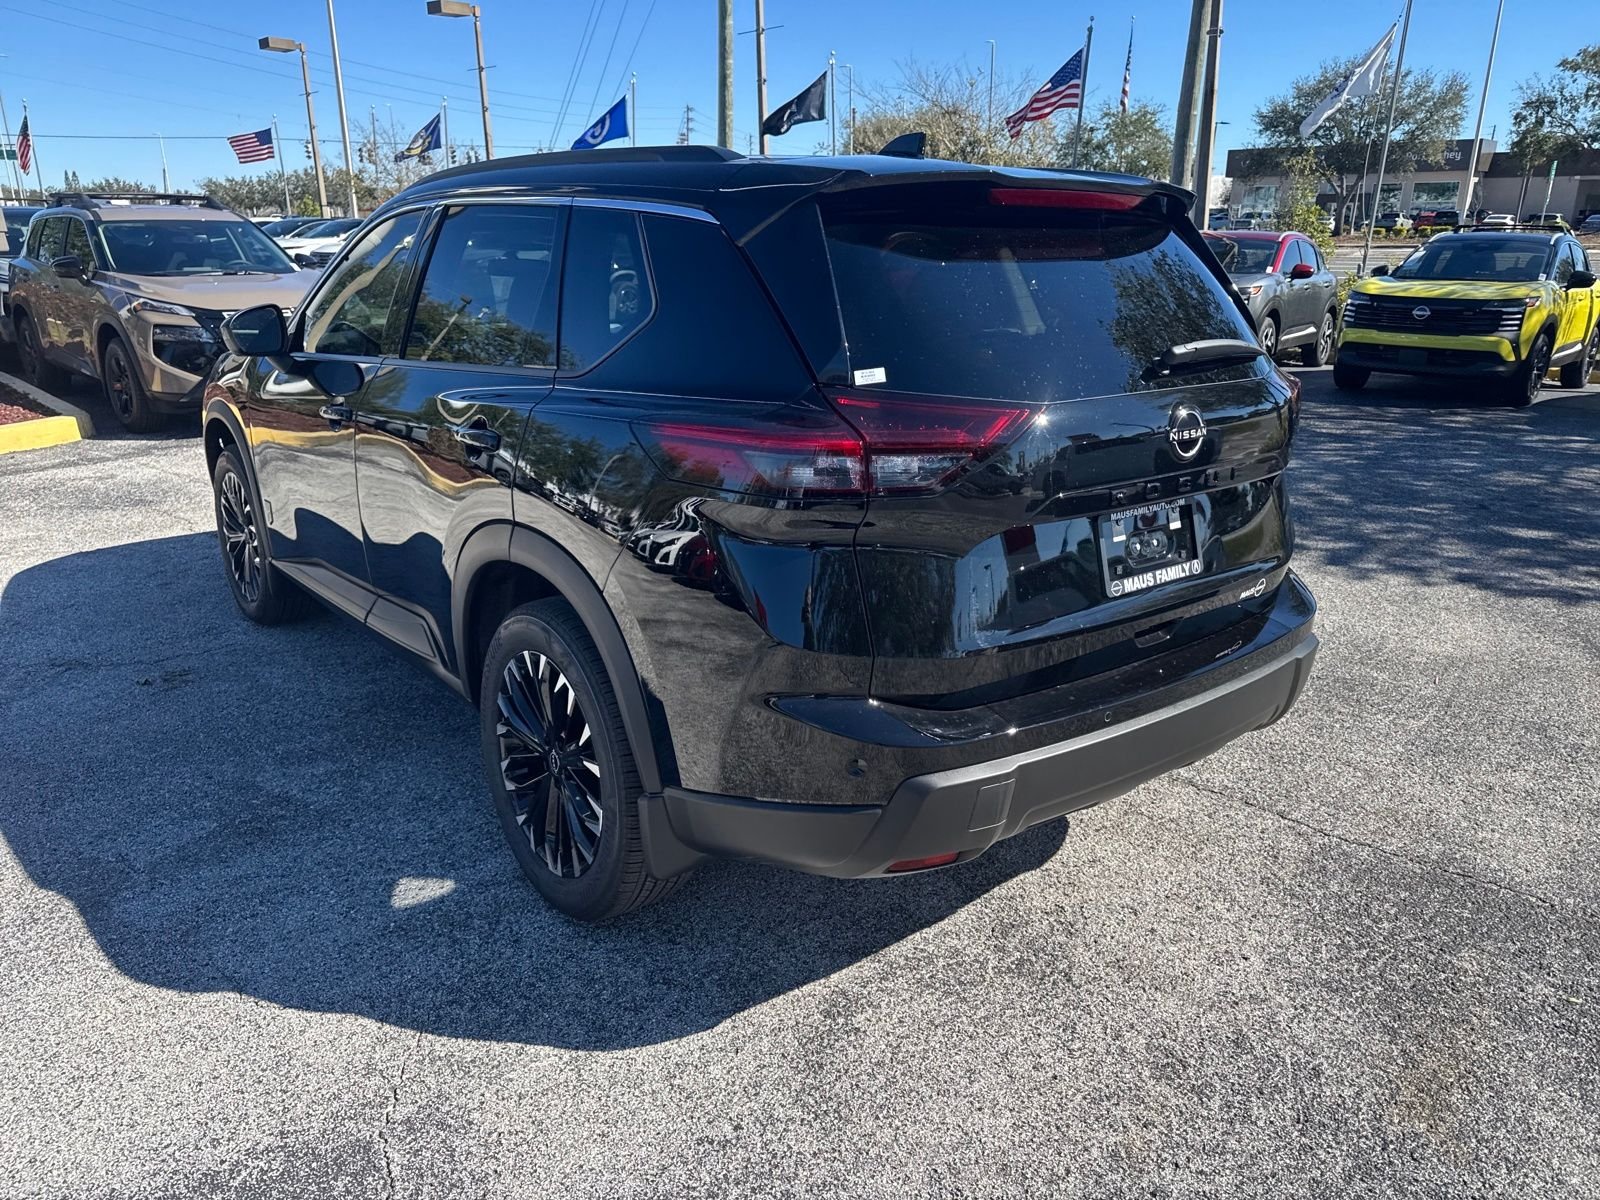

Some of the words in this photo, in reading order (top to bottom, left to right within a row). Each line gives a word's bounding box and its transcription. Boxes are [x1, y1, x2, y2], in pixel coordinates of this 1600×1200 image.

[1169, 427, 1207, 441] NISSAN
[1123, 572, 1155, 593] MAUS
[1155, 562, 1191, 585] FAMILY
